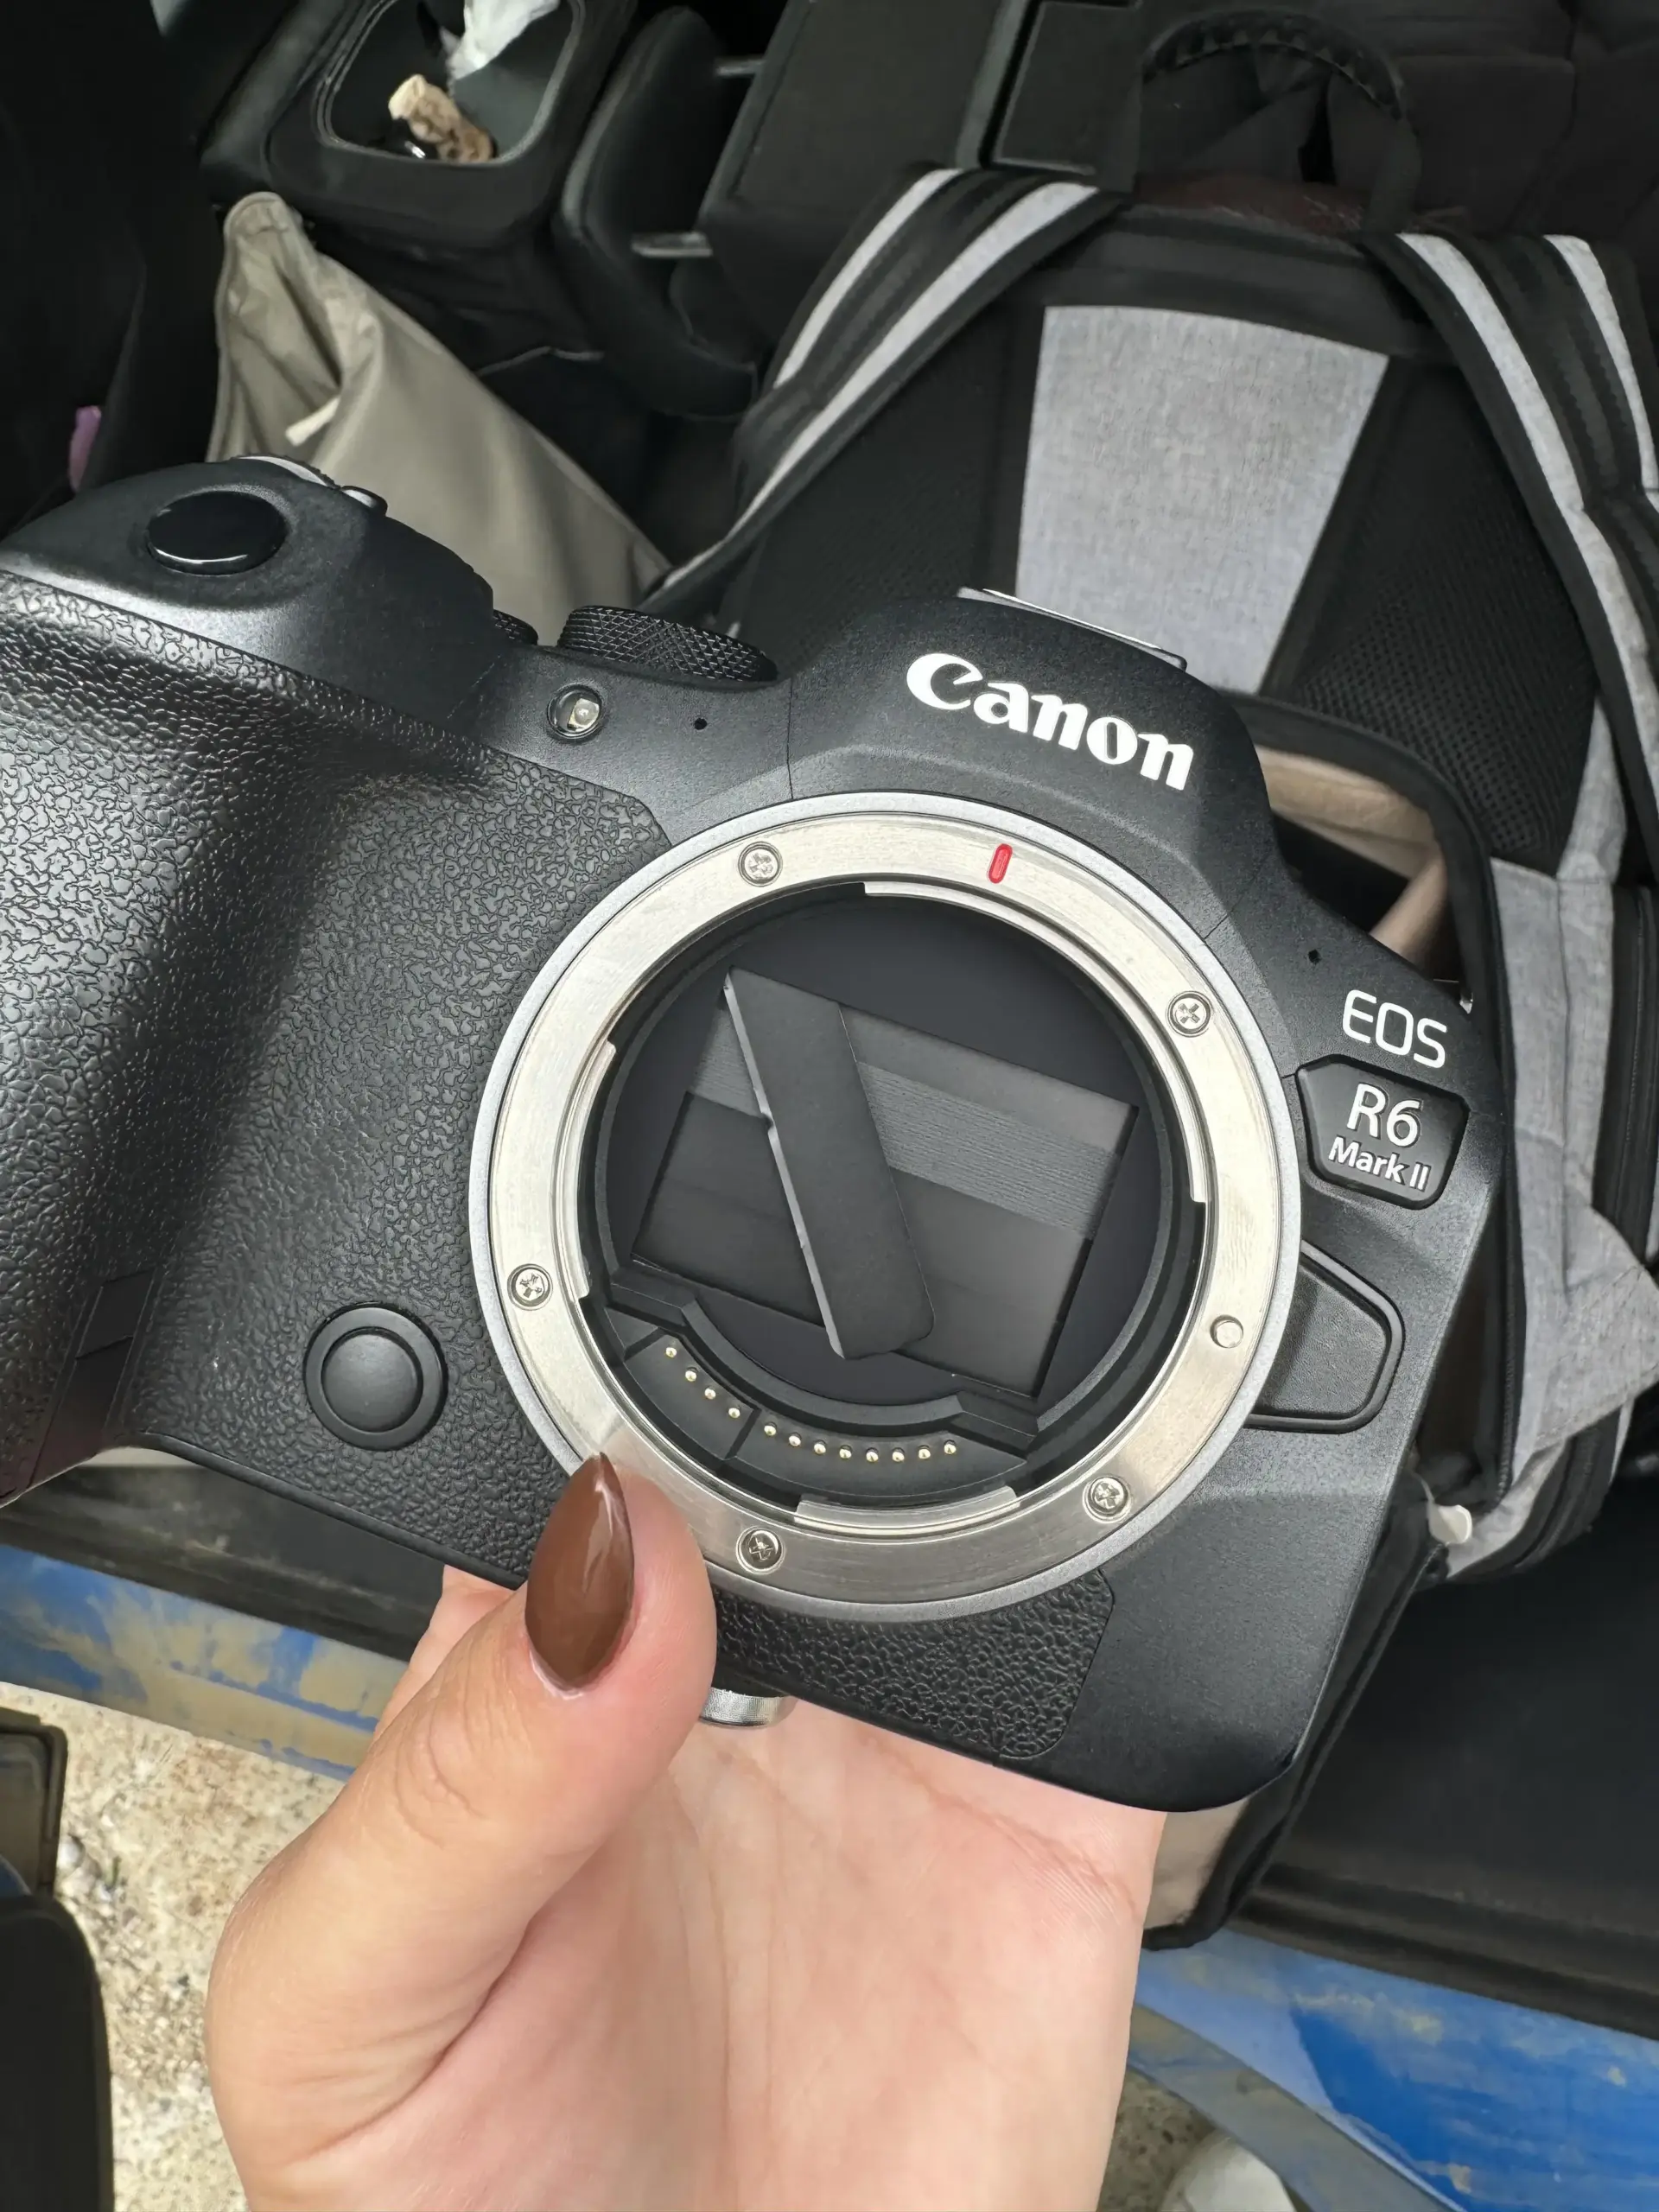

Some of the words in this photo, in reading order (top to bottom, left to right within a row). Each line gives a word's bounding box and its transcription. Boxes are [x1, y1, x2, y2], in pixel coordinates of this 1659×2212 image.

[906, 652, 1194, 791] Canon
[1342, 989, 1447, 1069] EOS
[1346, 1083, 1421, 1147] R6
[1328, 1136, 1405, 1184] Mark
[1409, 1163, 1430, 1191] II
